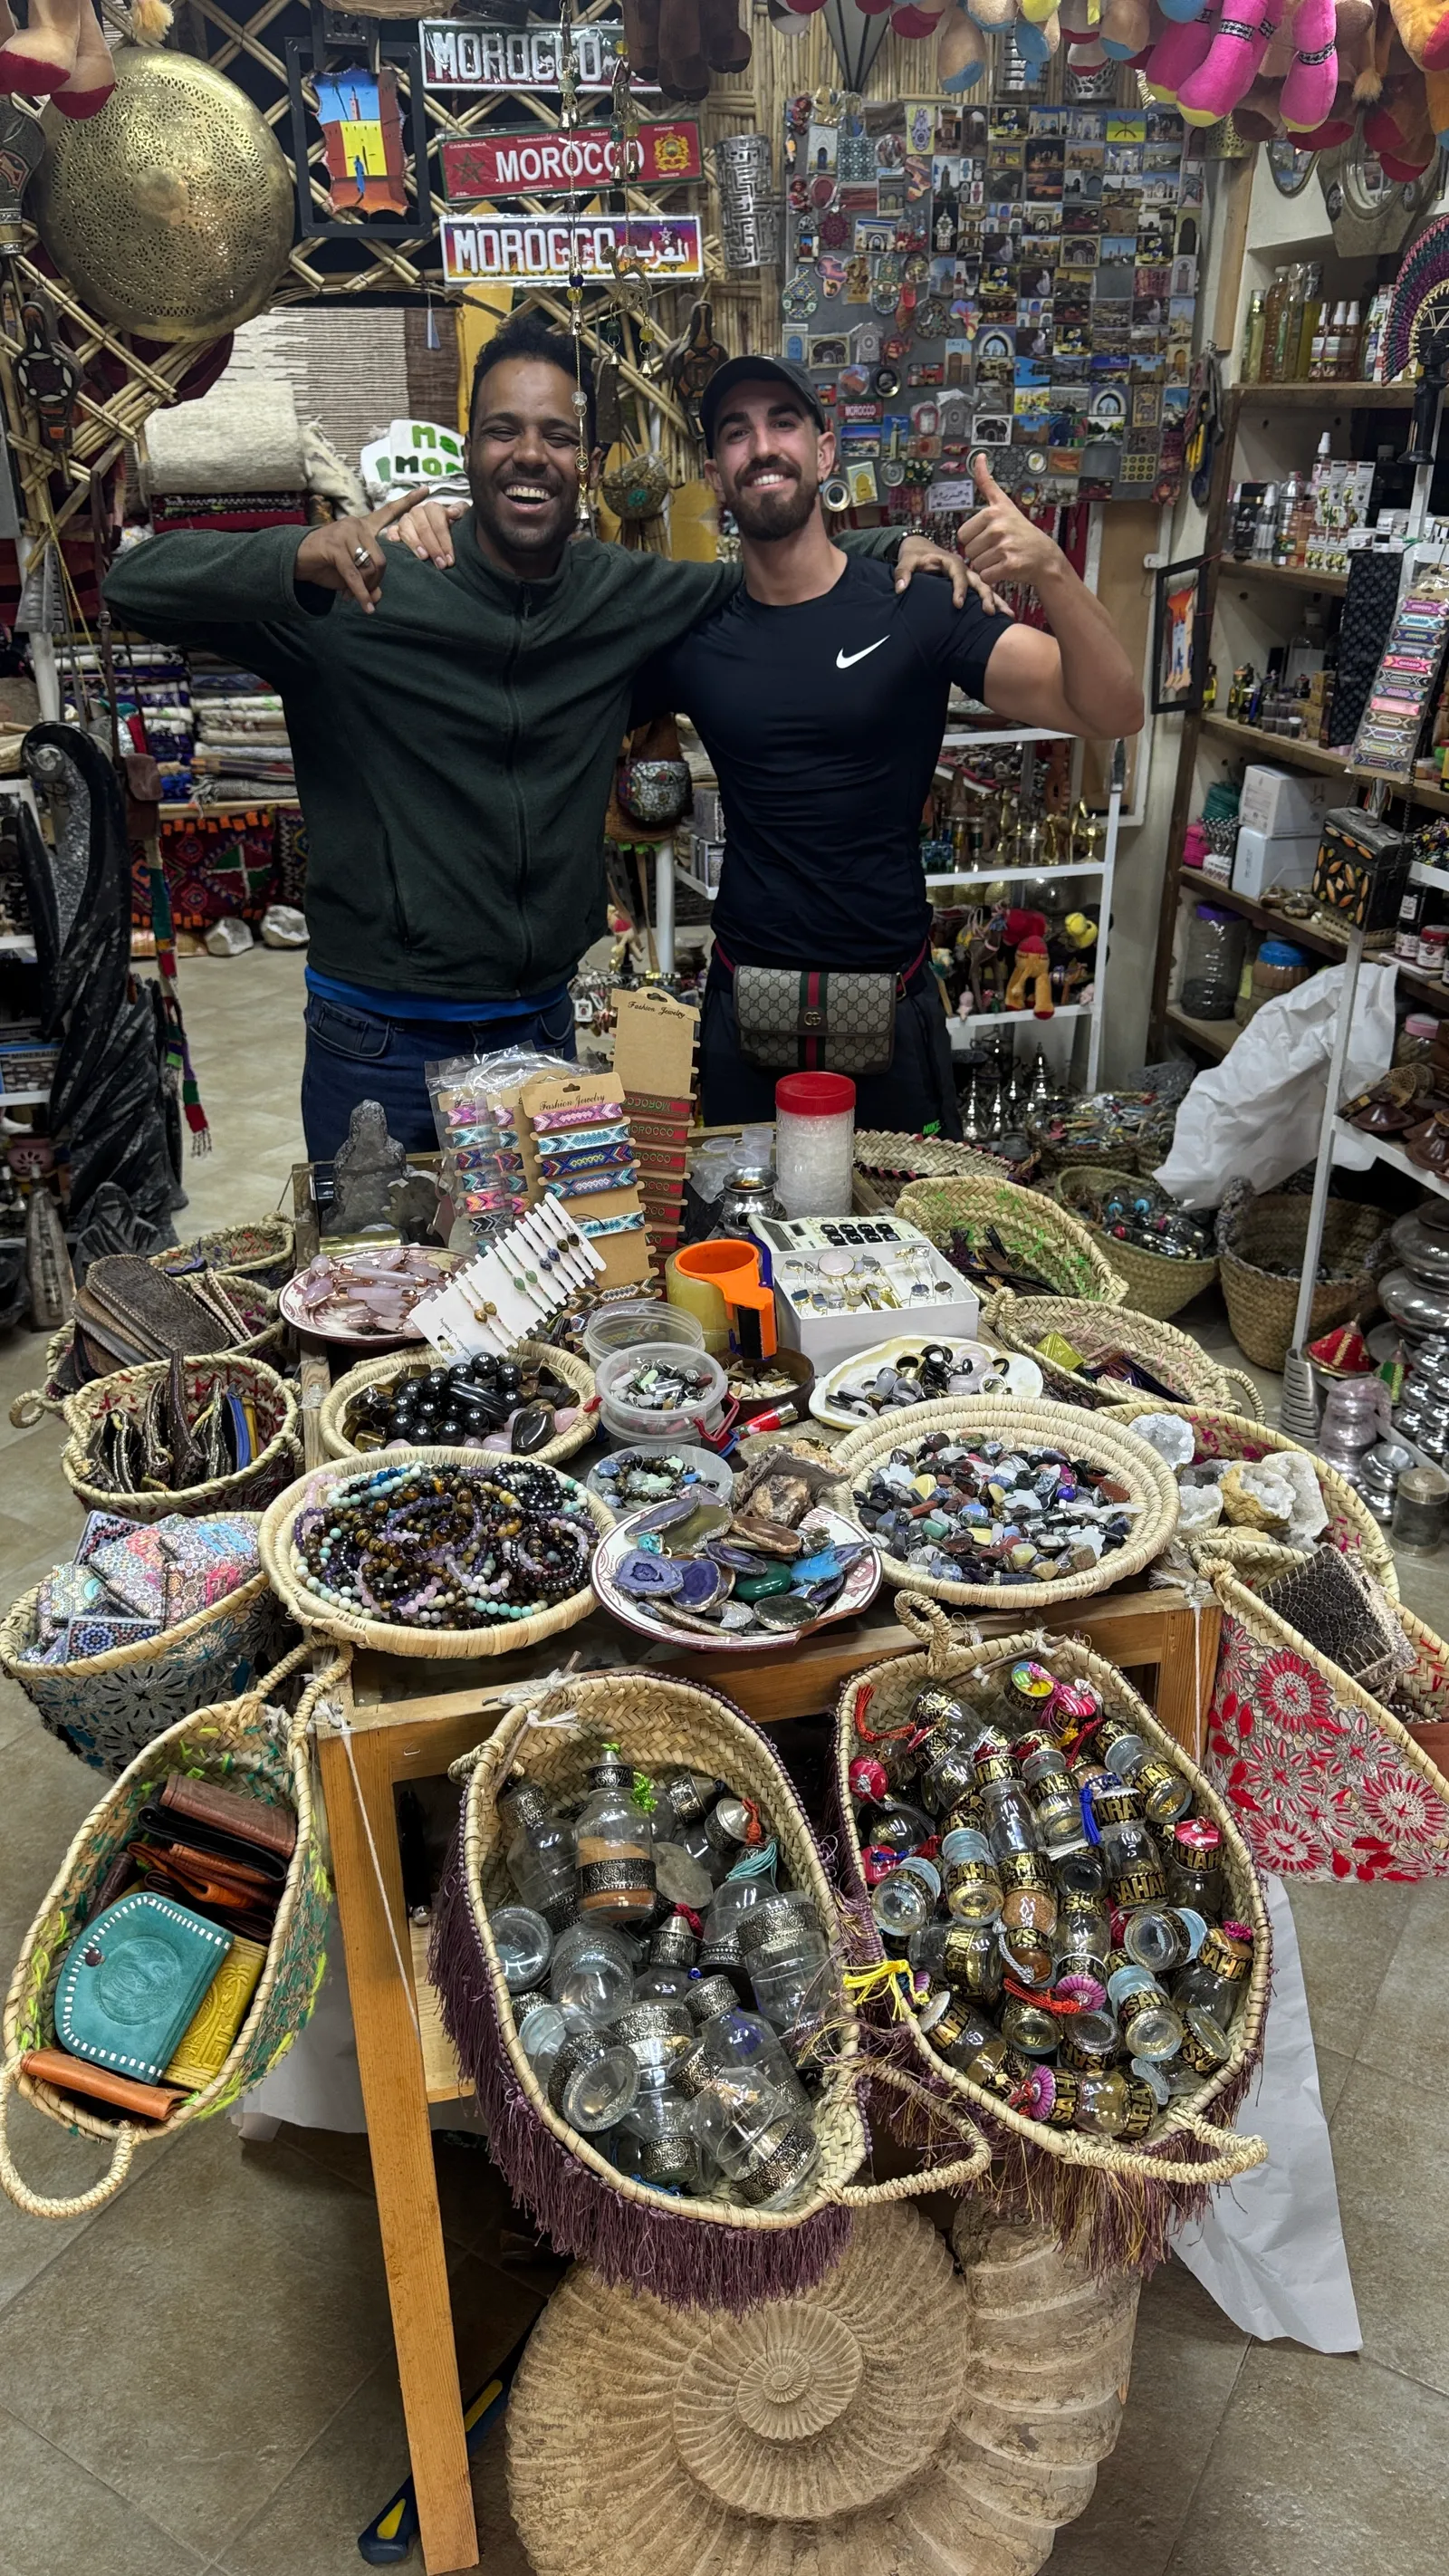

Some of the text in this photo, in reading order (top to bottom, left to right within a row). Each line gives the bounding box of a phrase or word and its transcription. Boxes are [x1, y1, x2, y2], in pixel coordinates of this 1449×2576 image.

[454, 227, 616, 274] MOROCCO
[845, 405, 876, 416] MOROCCO
[628, 1001, 686, 1020] Fashion Jewelry
[540, 1092, 606, 1111] Fashion Jewelry
